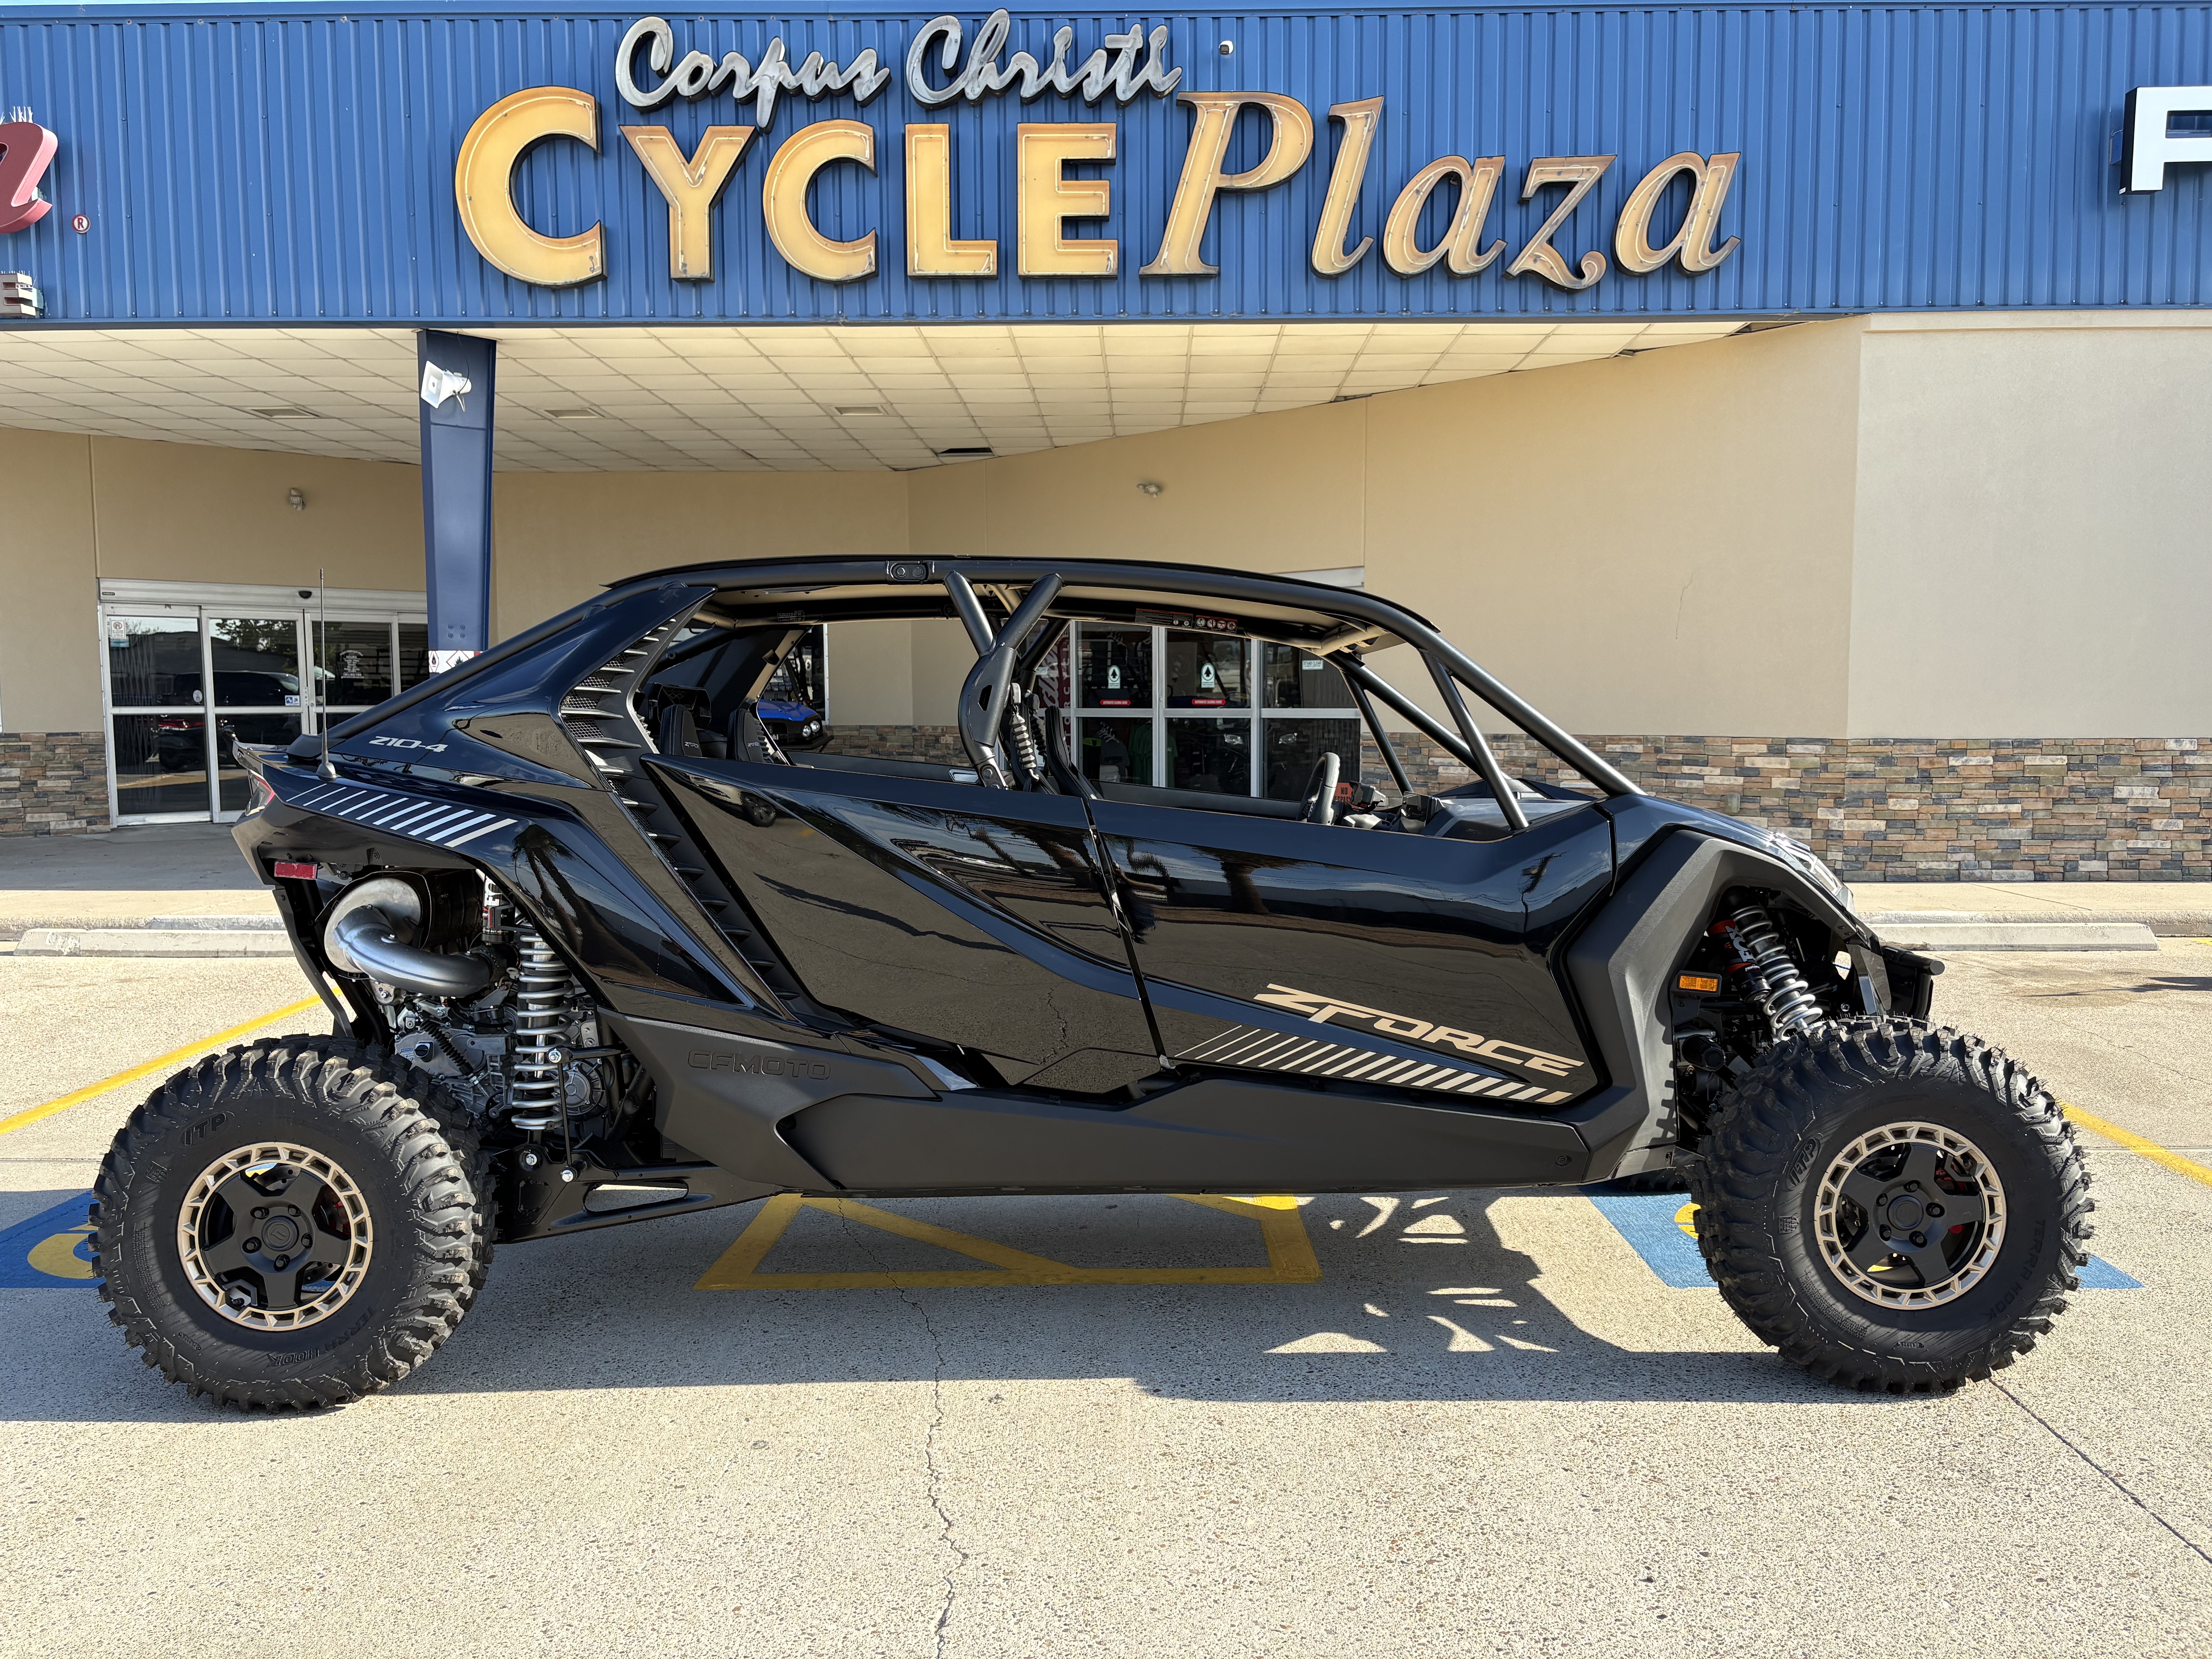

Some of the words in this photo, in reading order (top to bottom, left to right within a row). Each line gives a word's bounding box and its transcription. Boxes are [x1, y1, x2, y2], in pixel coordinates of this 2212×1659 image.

[616, 15, 891, 134] Corpus
[906, 7, 1184, 112] Christi
[455, 85, 1119, 290] CYCLE
[1139, 90, 1742, 294] Plaza
[368, 735, 448, 752] Z10-4
[484, 874, 502, 907] FO
[1253, 983, 1585, 1077] ZFORCE
[687, 1049, 831, 1080] CFMOTO
[185, 1113, 227, 1146] ITP
[1790, 1137, 1816, 1186] ITP
[266, 1348, 319, 1367] HOOK
